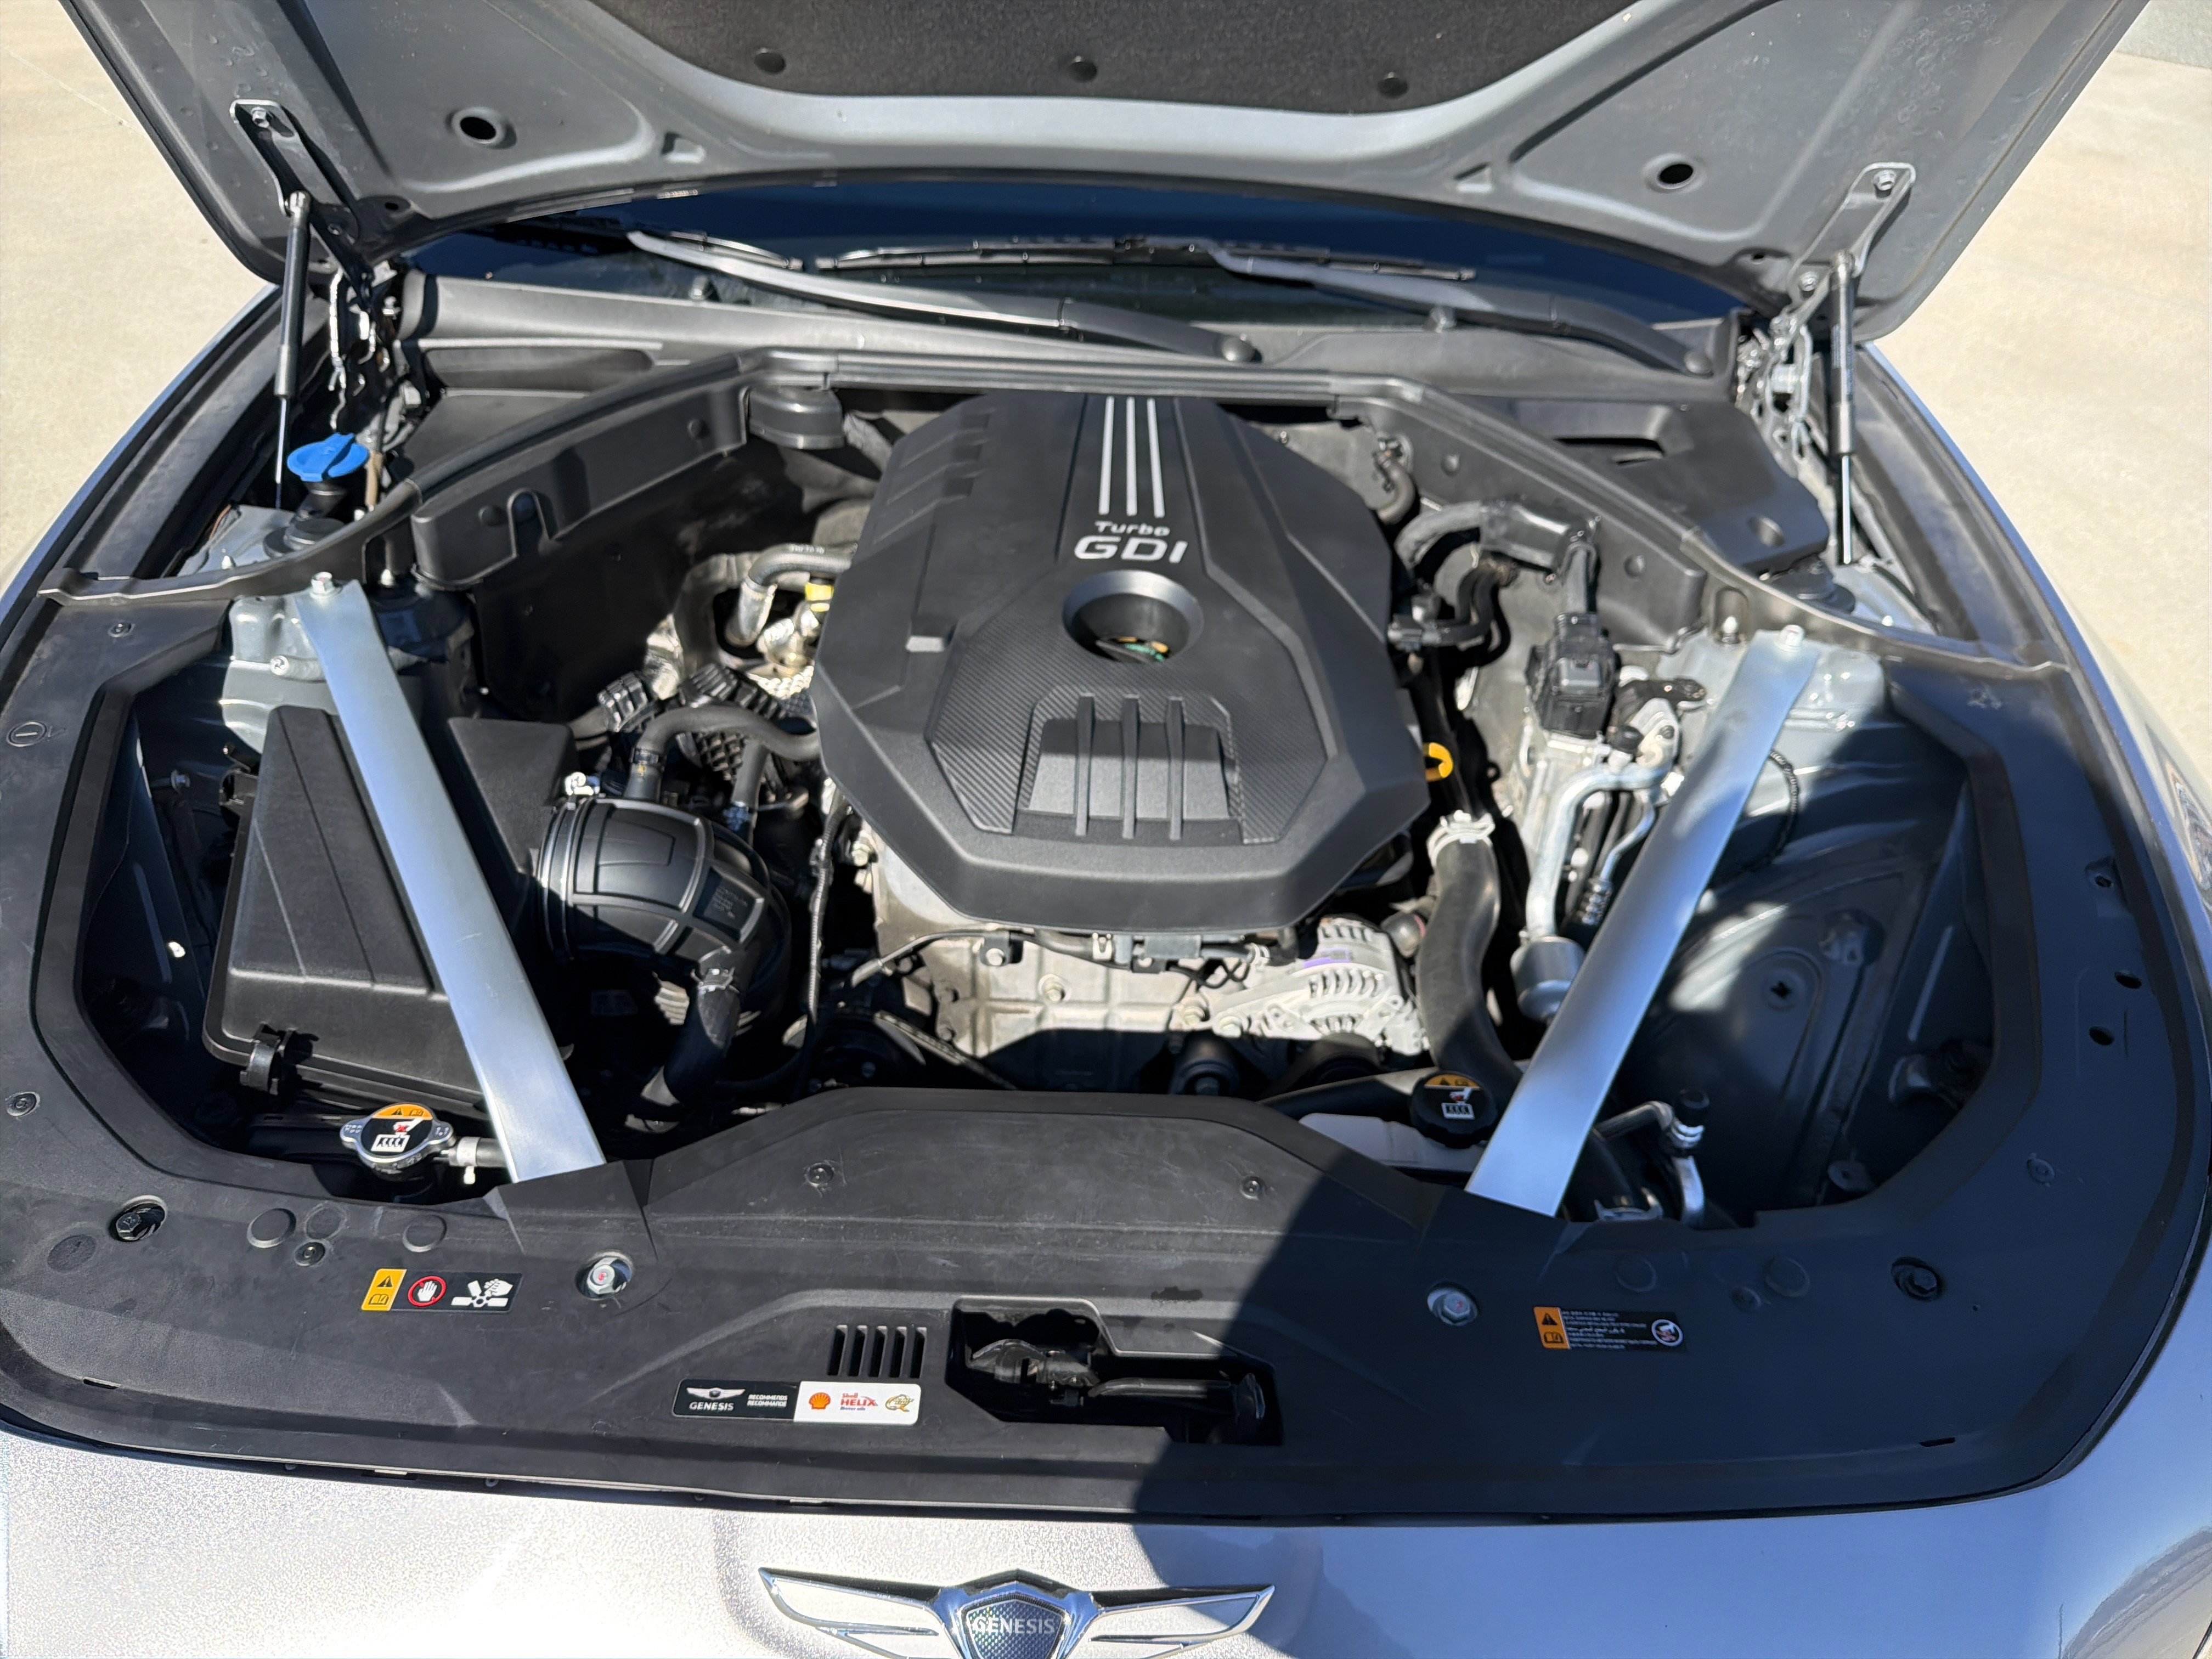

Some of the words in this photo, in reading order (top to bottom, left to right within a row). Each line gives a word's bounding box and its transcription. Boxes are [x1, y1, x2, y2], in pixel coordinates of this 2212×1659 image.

[1094, 521, 1171, 537] Turbo
[1074, 534, 1188, 563] GDI
[689, 1401, 735, 1411] GENESIS
[974, 1618, 1056, 1635] GENESIS
